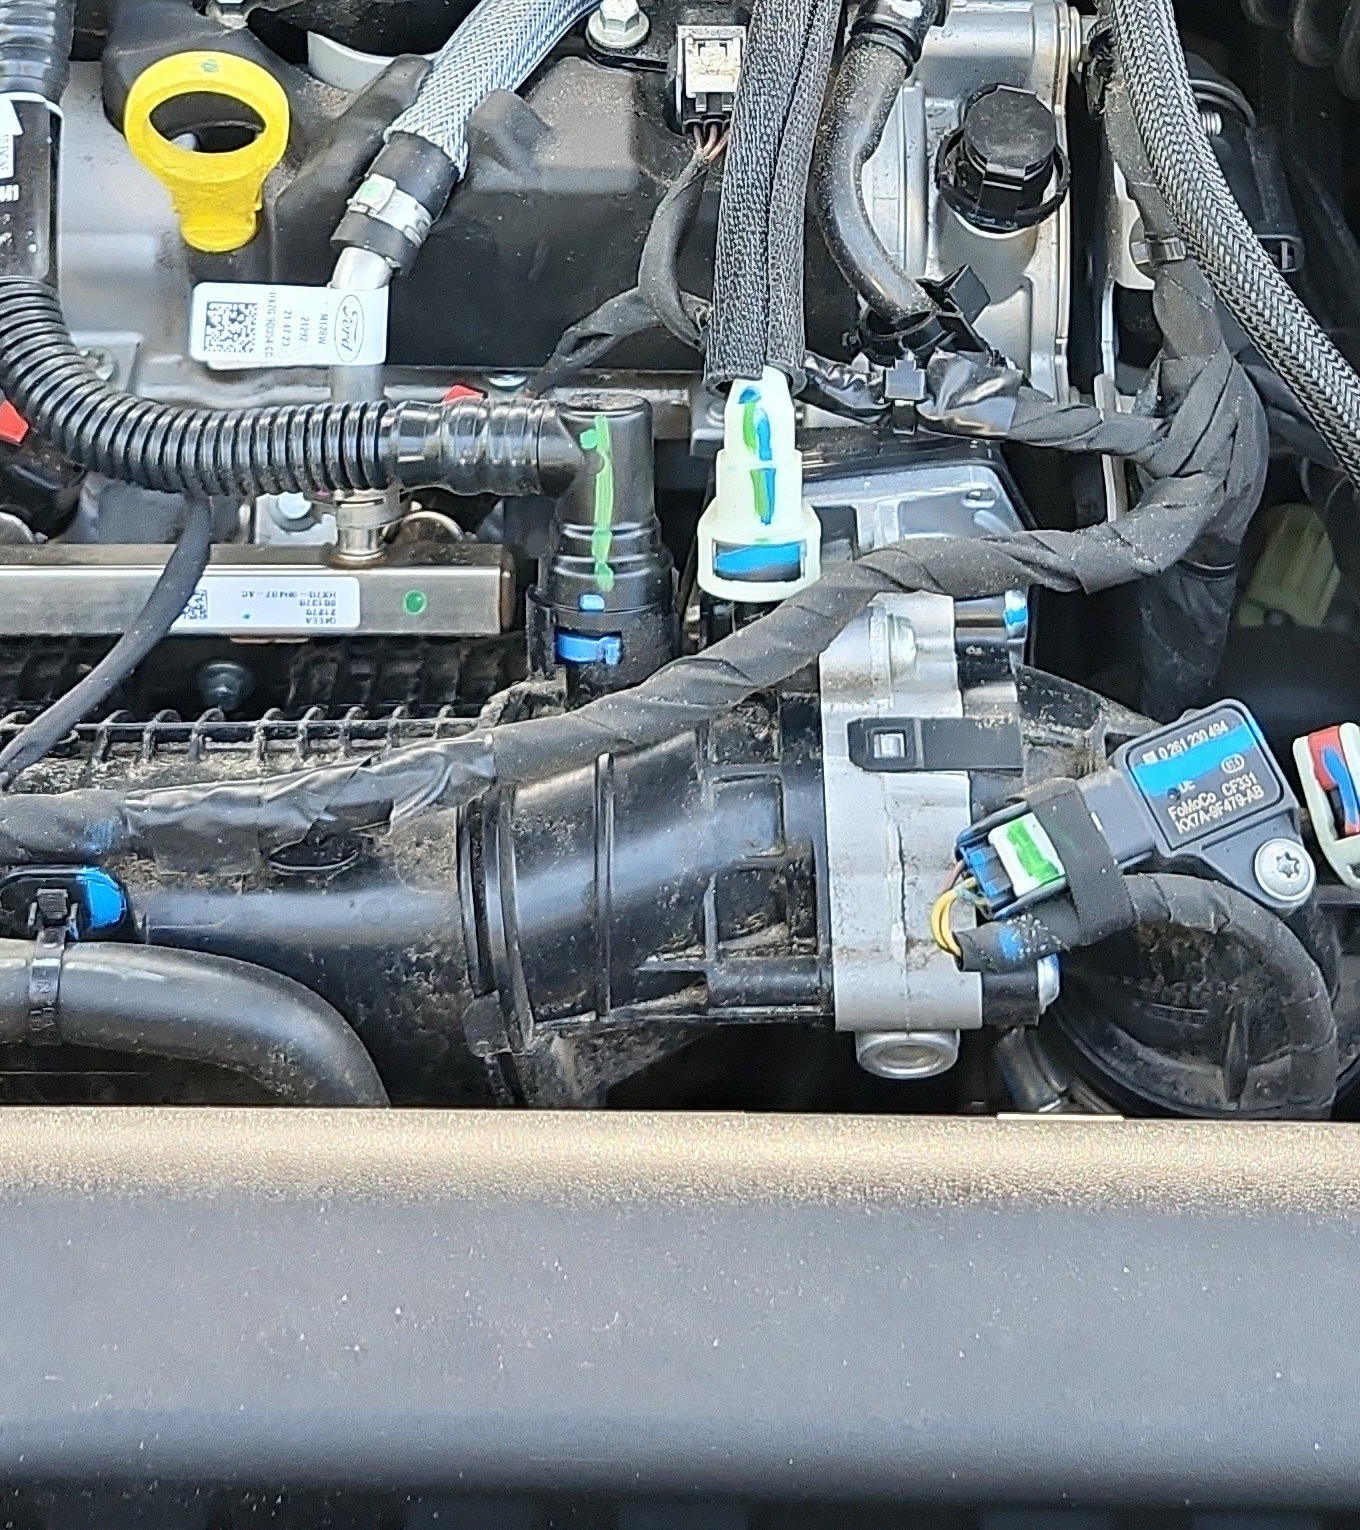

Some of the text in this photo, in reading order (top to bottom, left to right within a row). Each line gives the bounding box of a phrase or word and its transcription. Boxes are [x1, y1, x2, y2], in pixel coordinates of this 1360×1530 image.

[340, 305, 358, 351] Ford
[1167, 770, 1258, 821] FoMoCo CF331
